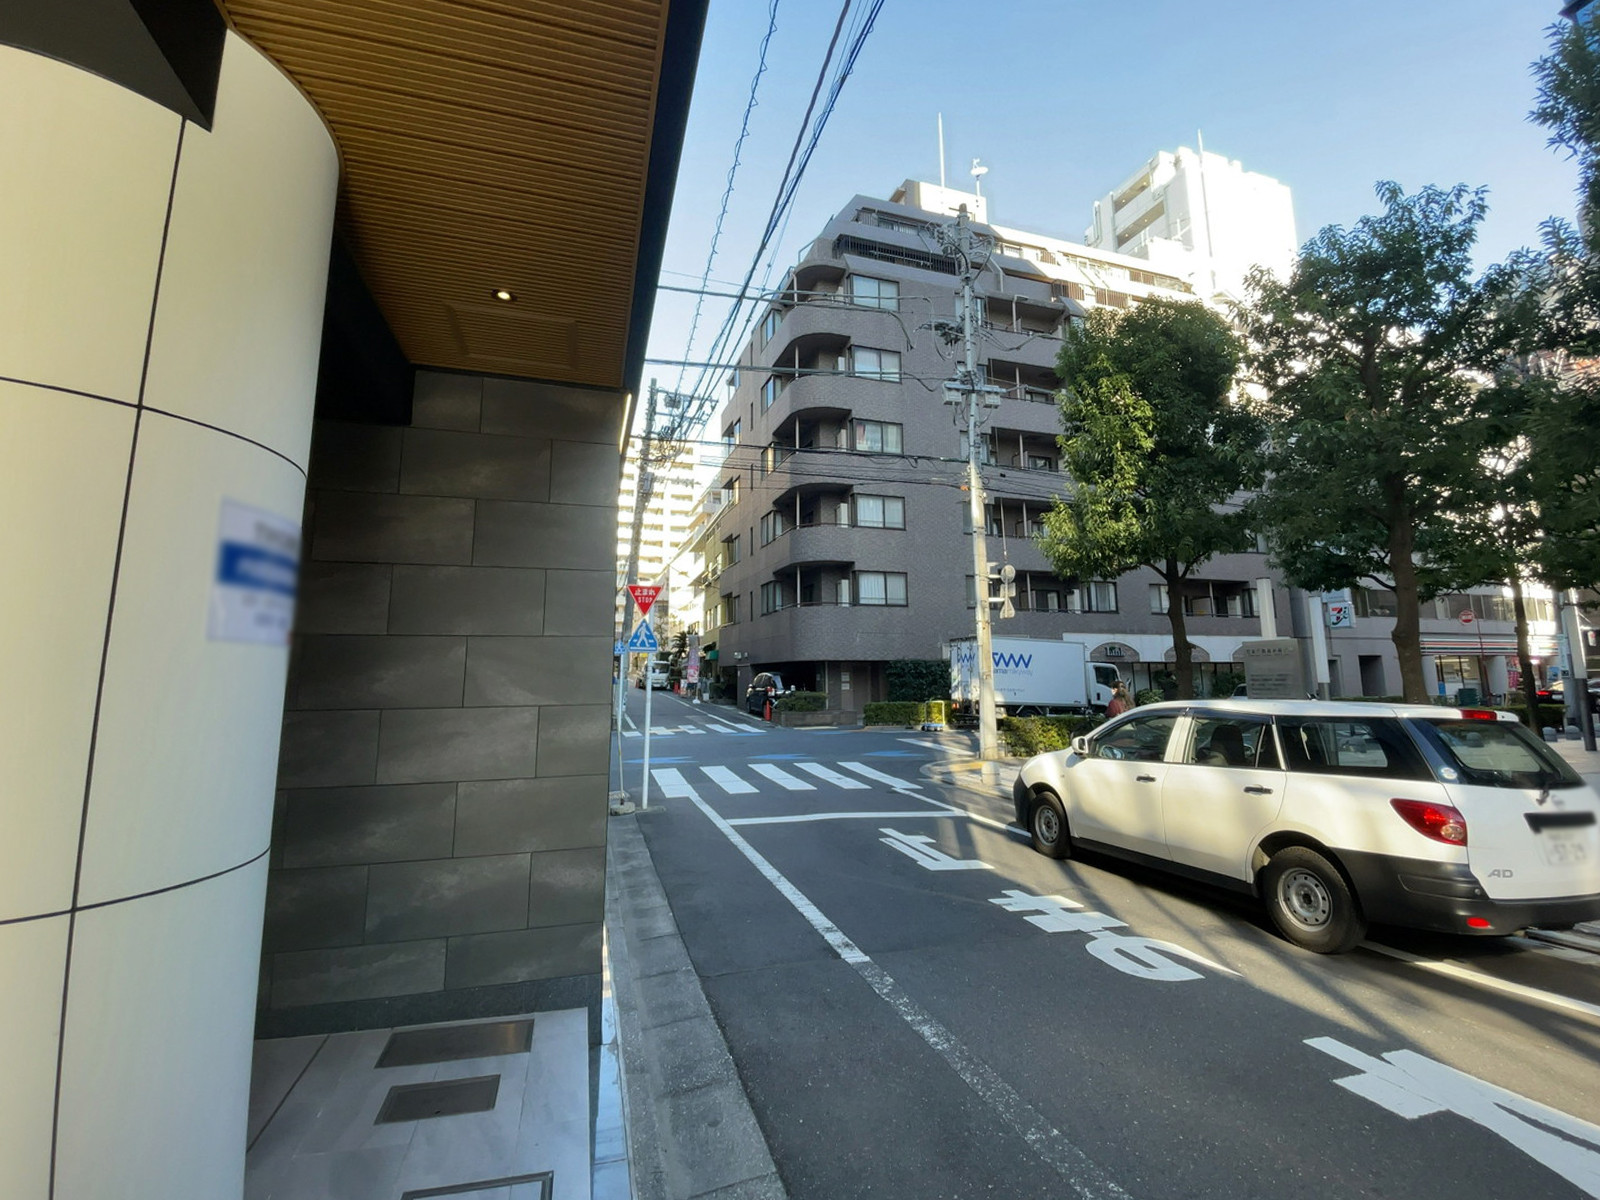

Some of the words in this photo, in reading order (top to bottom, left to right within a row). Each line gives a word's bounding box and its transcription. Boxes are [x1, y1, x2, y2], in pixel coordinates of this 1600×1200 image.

[634, 588, 656, 596] 止まれ
[1487, 868, 1514, 879] AD
